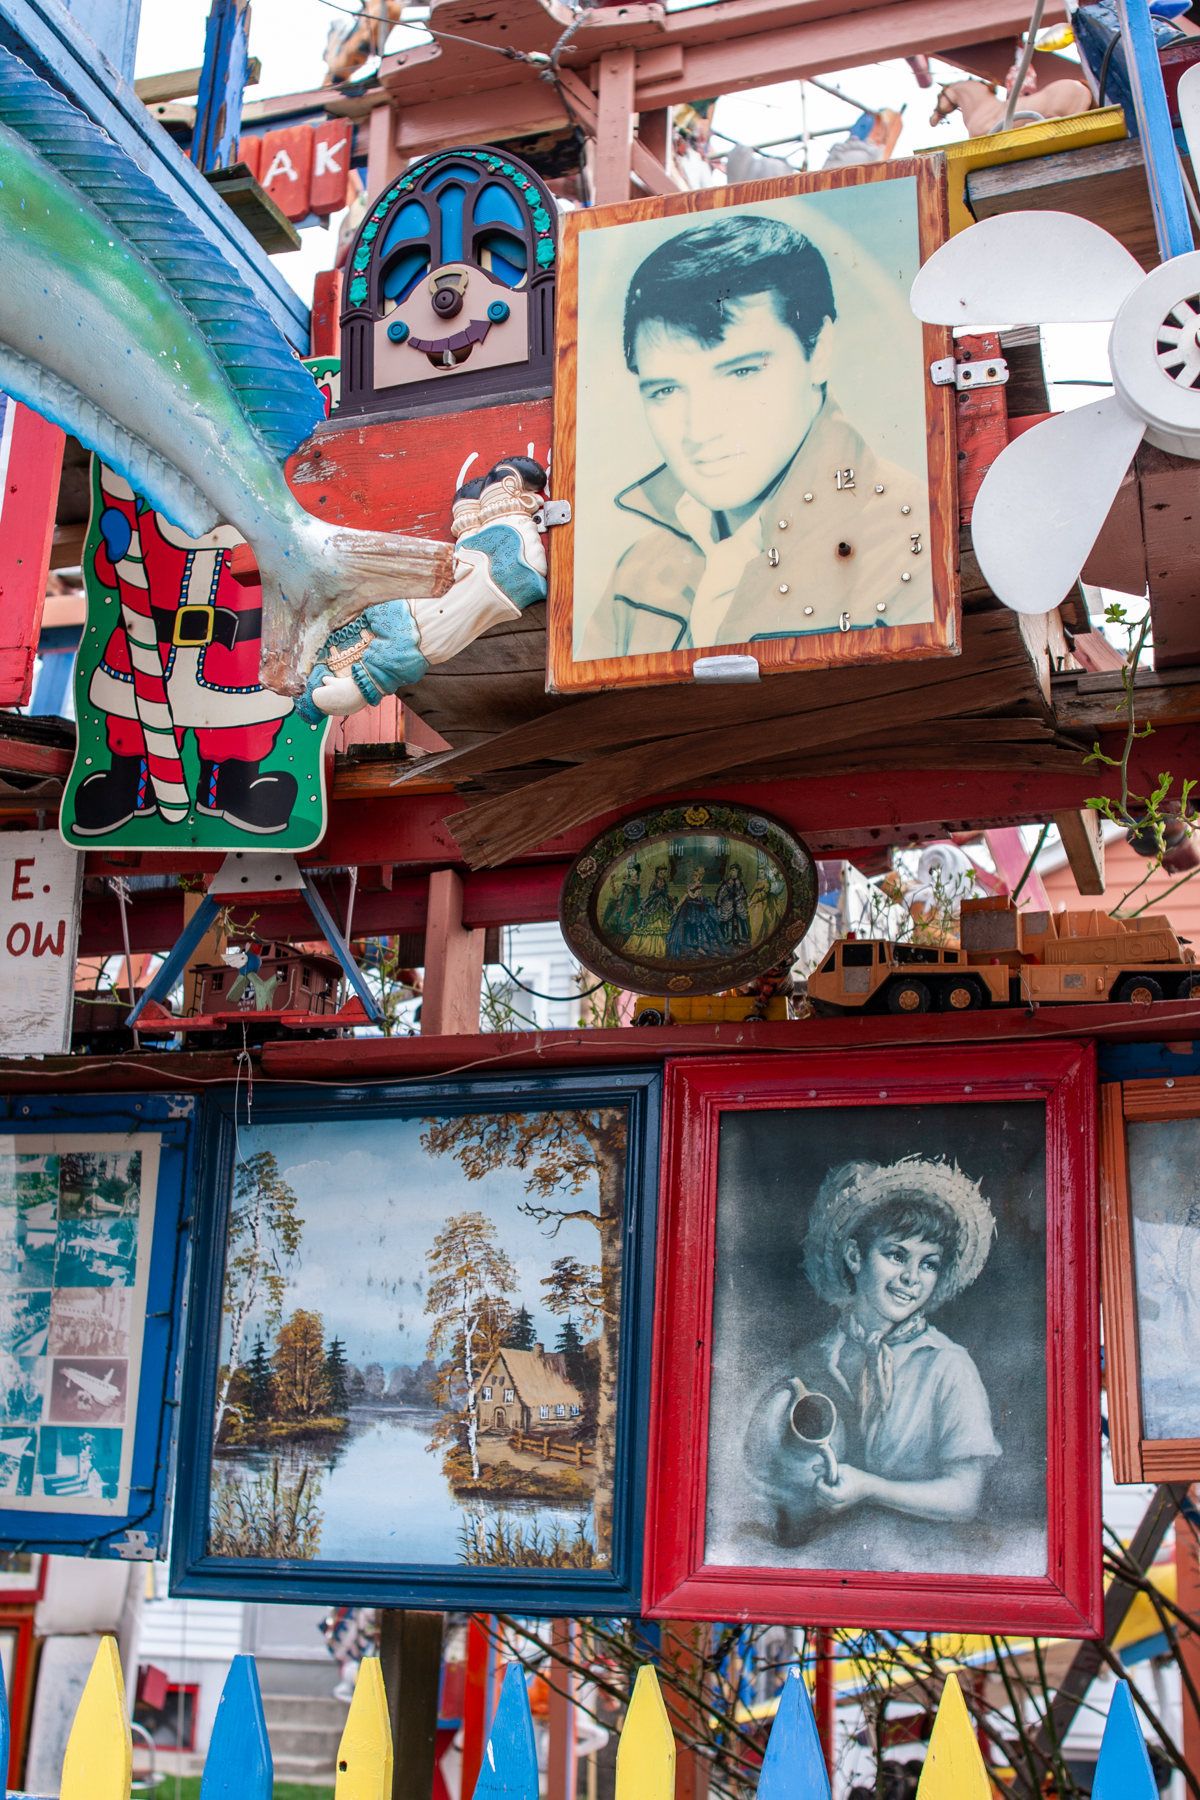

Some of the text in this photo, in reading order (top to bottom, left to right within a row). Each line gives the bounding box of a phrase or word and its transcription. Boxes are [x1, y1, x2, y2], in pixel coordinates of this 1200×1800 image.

[262, 138, 347, 188] AK
[834, 468, 856, 491] 12
[910, 533, 923, 555] 3
[767, 547, 780, 568] 9
[839, 611, 851, 633] 6
[12, 856, 51, 901] E.
[6, 919, 66, 958] OW
